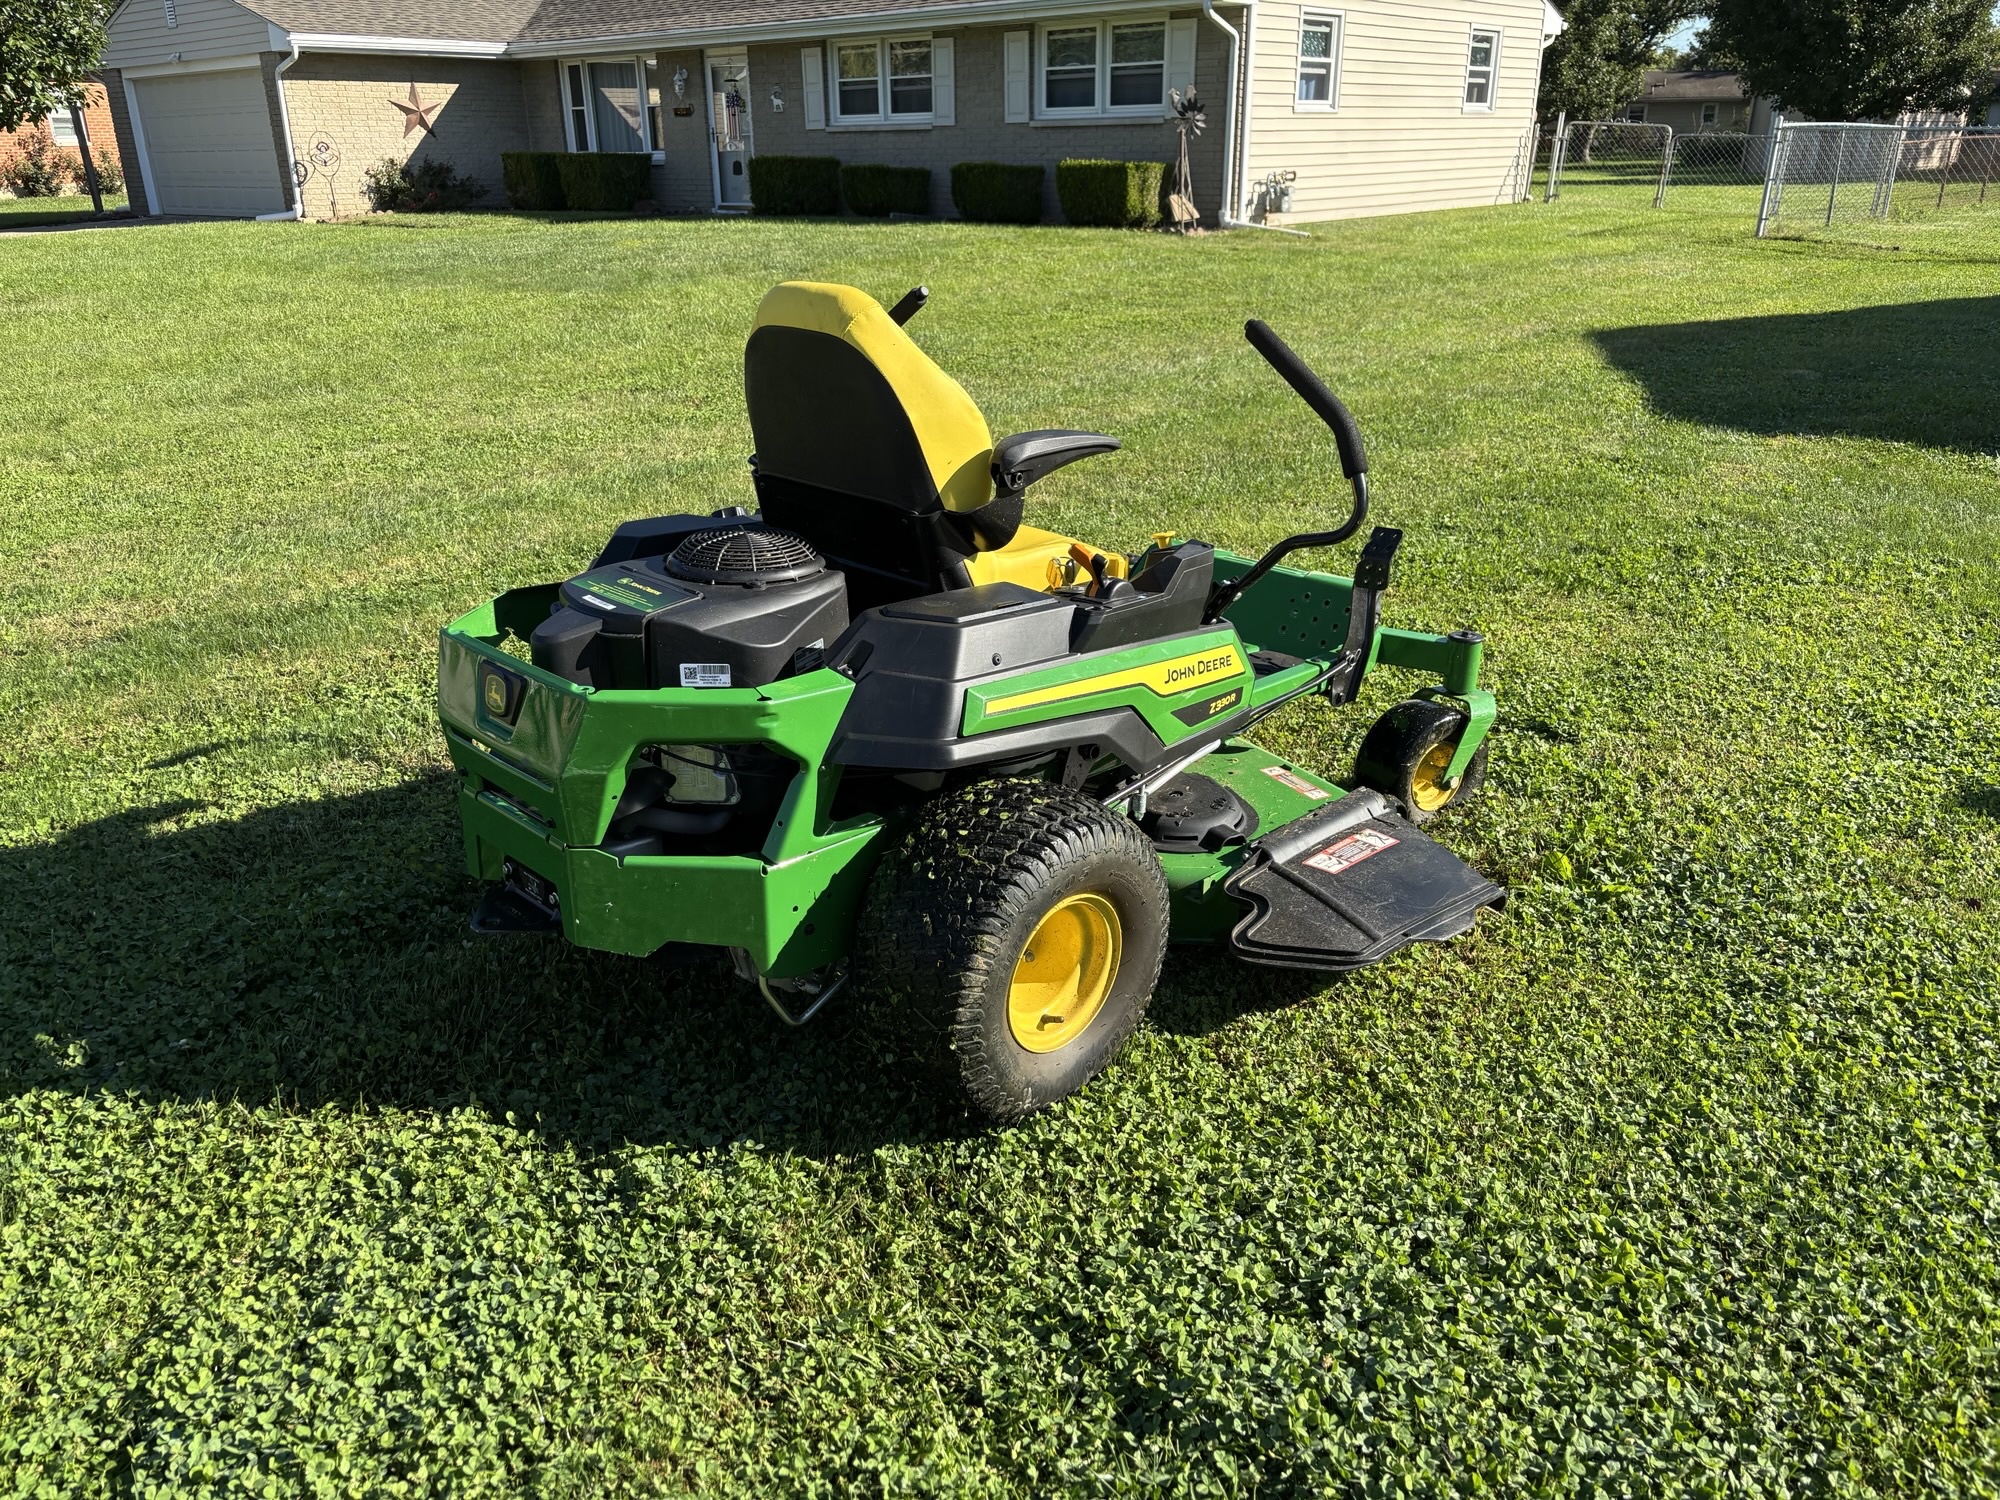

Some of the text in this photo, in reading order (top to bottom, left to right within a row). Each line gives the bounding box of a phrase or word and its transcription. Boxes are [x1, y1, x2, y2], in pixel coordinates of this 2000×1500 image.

[1164, 655, 1232, 684] JOHN DEERE
[1209, 693, 1236, 714] Z330R
